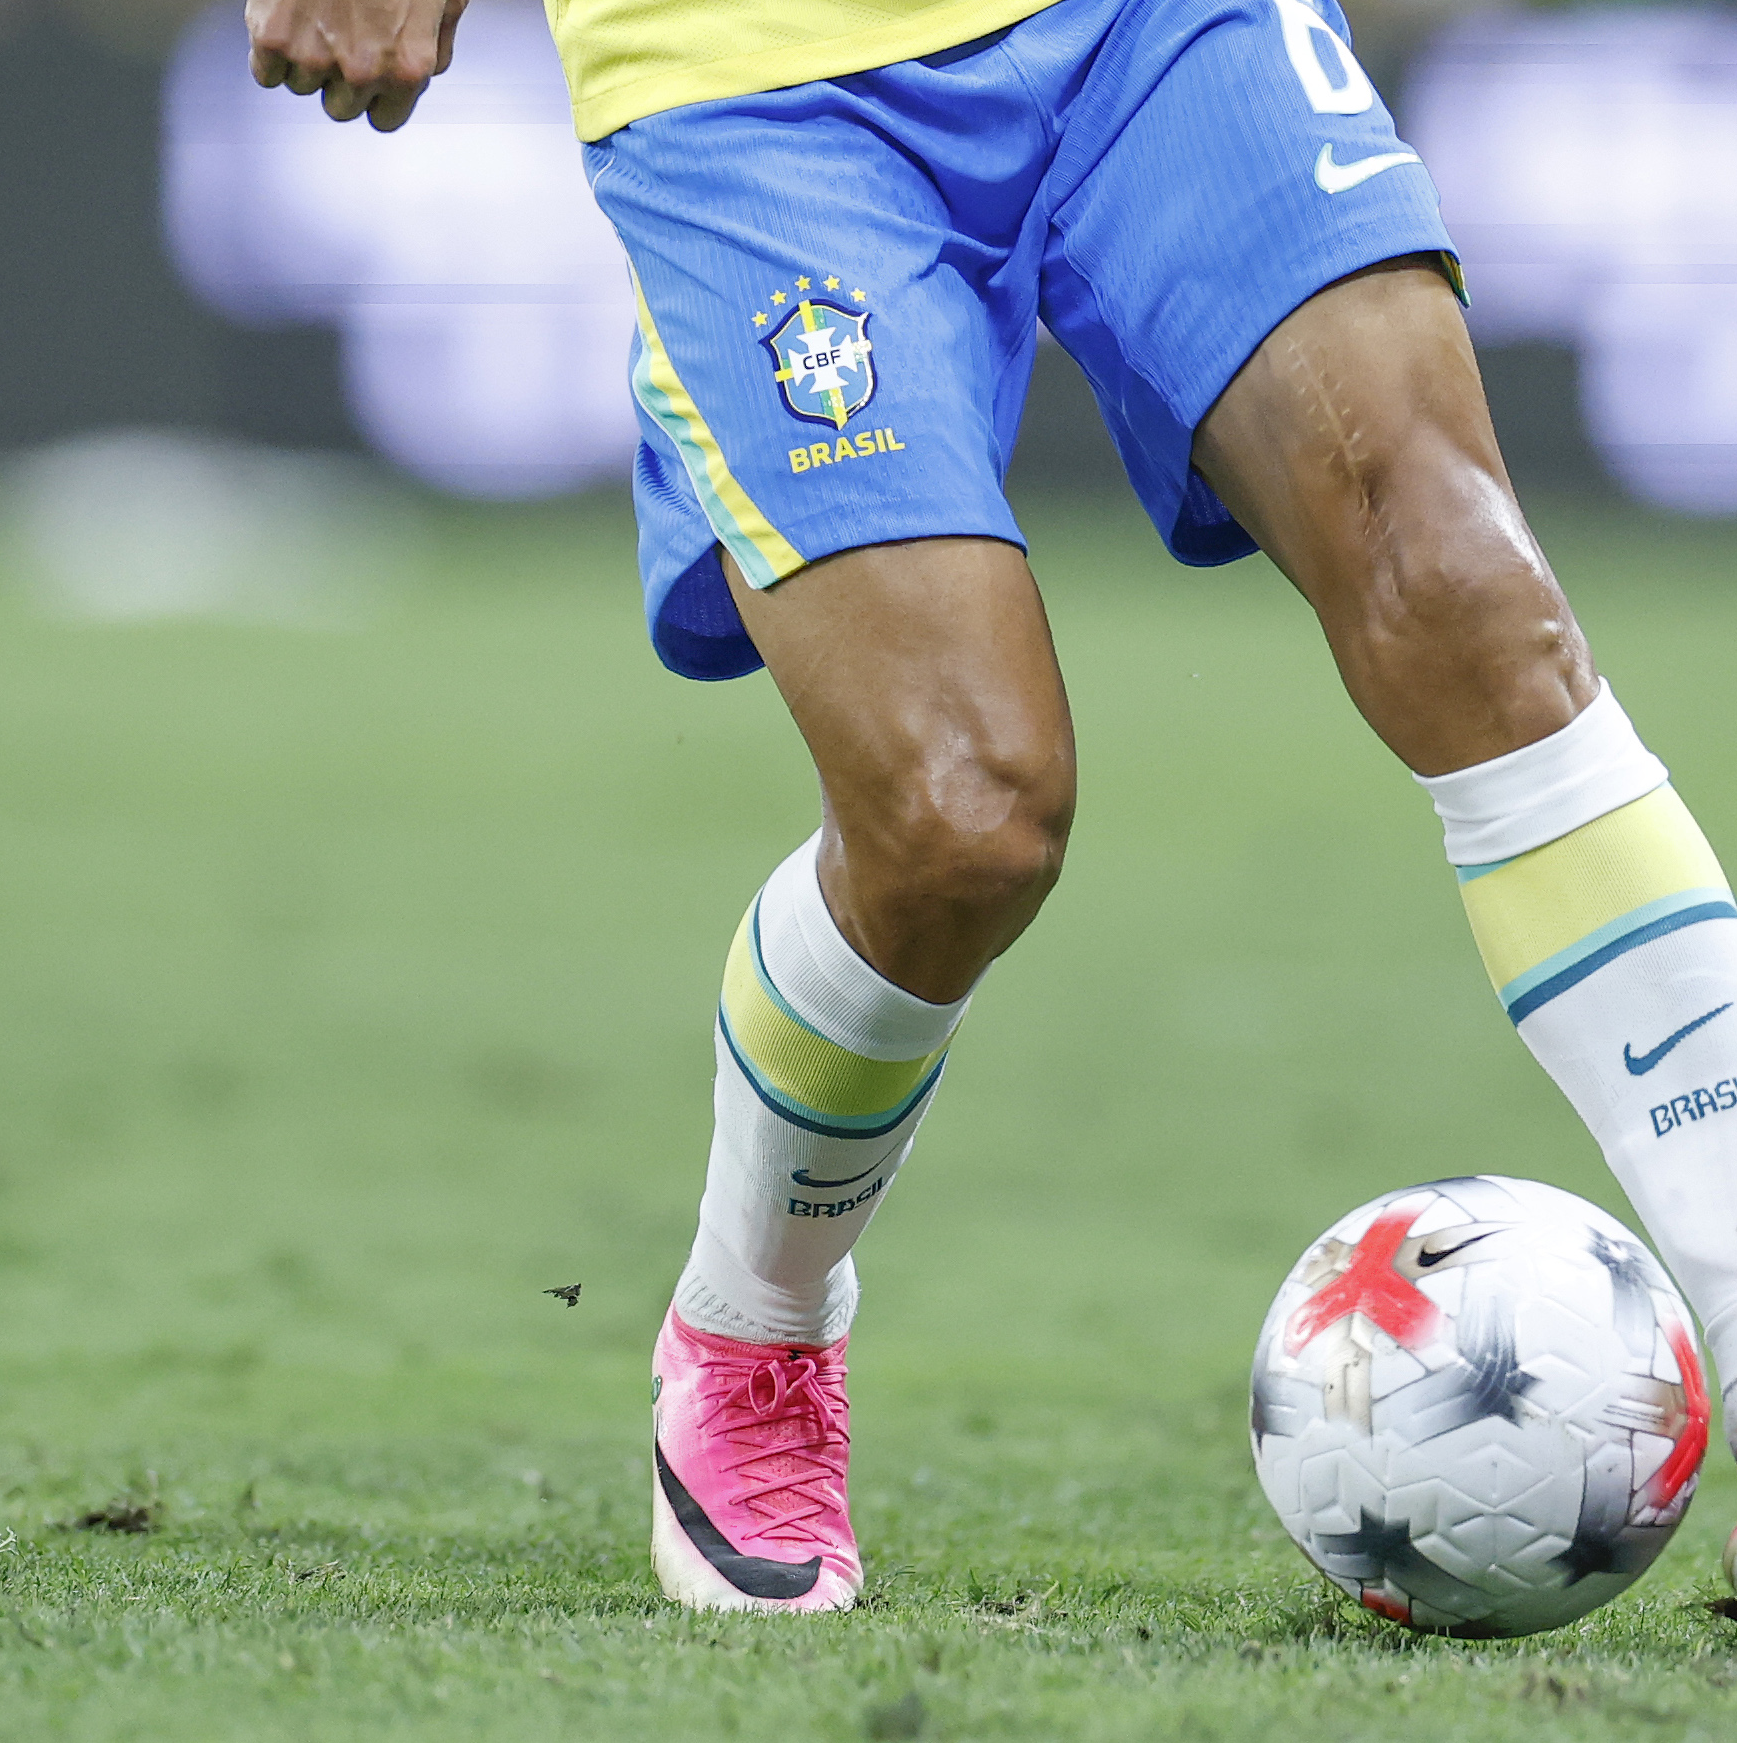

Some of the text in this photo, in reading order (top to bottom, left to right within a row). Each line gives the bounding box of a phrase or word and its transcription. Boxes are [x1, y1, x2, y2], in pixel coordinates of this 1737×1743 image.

[803, 349, 840, 370] CBF
[788, 427, 906, 474] BRASIL
[787, 1176, 883, 1218] BRASIL
